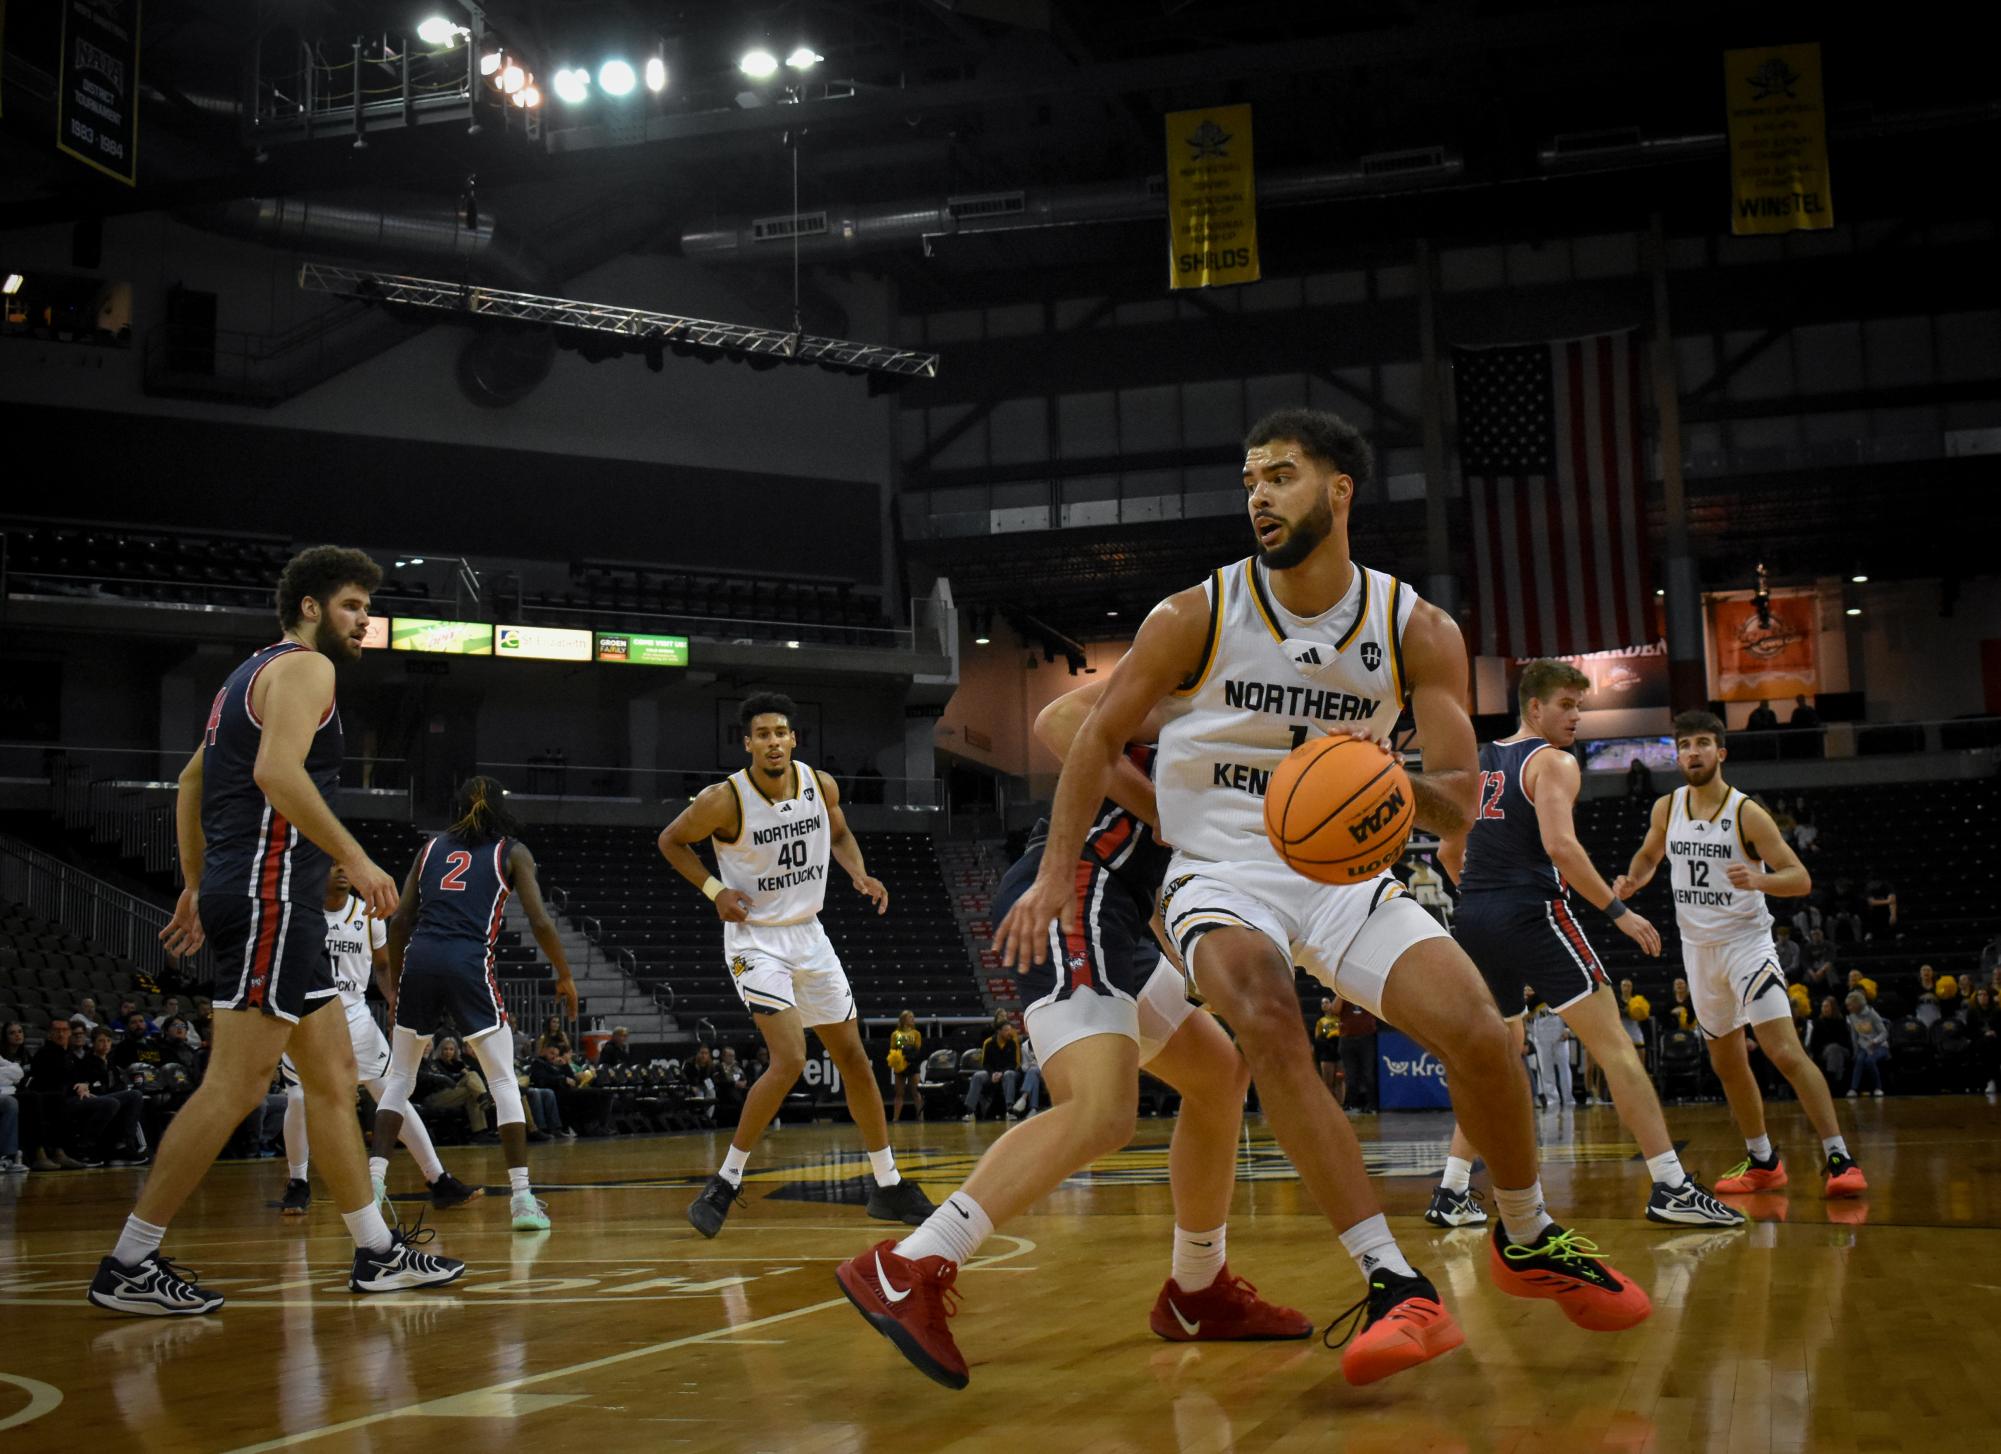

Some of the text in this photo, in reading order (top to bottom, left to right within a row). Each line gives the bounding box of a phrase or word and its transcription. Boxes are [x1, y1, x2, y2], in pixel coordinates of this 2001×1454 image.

[1739, 193, 1826, 218] WINSTEL
[600, 638, 627, 647] GROEN
[600, 645, 627, 654] FAMILY
[1225, 680, 1381, 721] NORTHERN
[1476, 771, 1505, 820] 12
[1348, 786, 1405, 844] NCAA
[753, 815, 821, 845] NORTHERN
[778, 840, 808, 870] 40
[1670, 840, 1732, 859] NORTHERN
[440, 851, 472, 891] 2
[758, 865, 824, 892] KENTUCKY
[1687, 860, 1710, 888] 12
[1674, 888, 1733, 906] KENTUCKY
[327, 939, 363, 954] THERN
